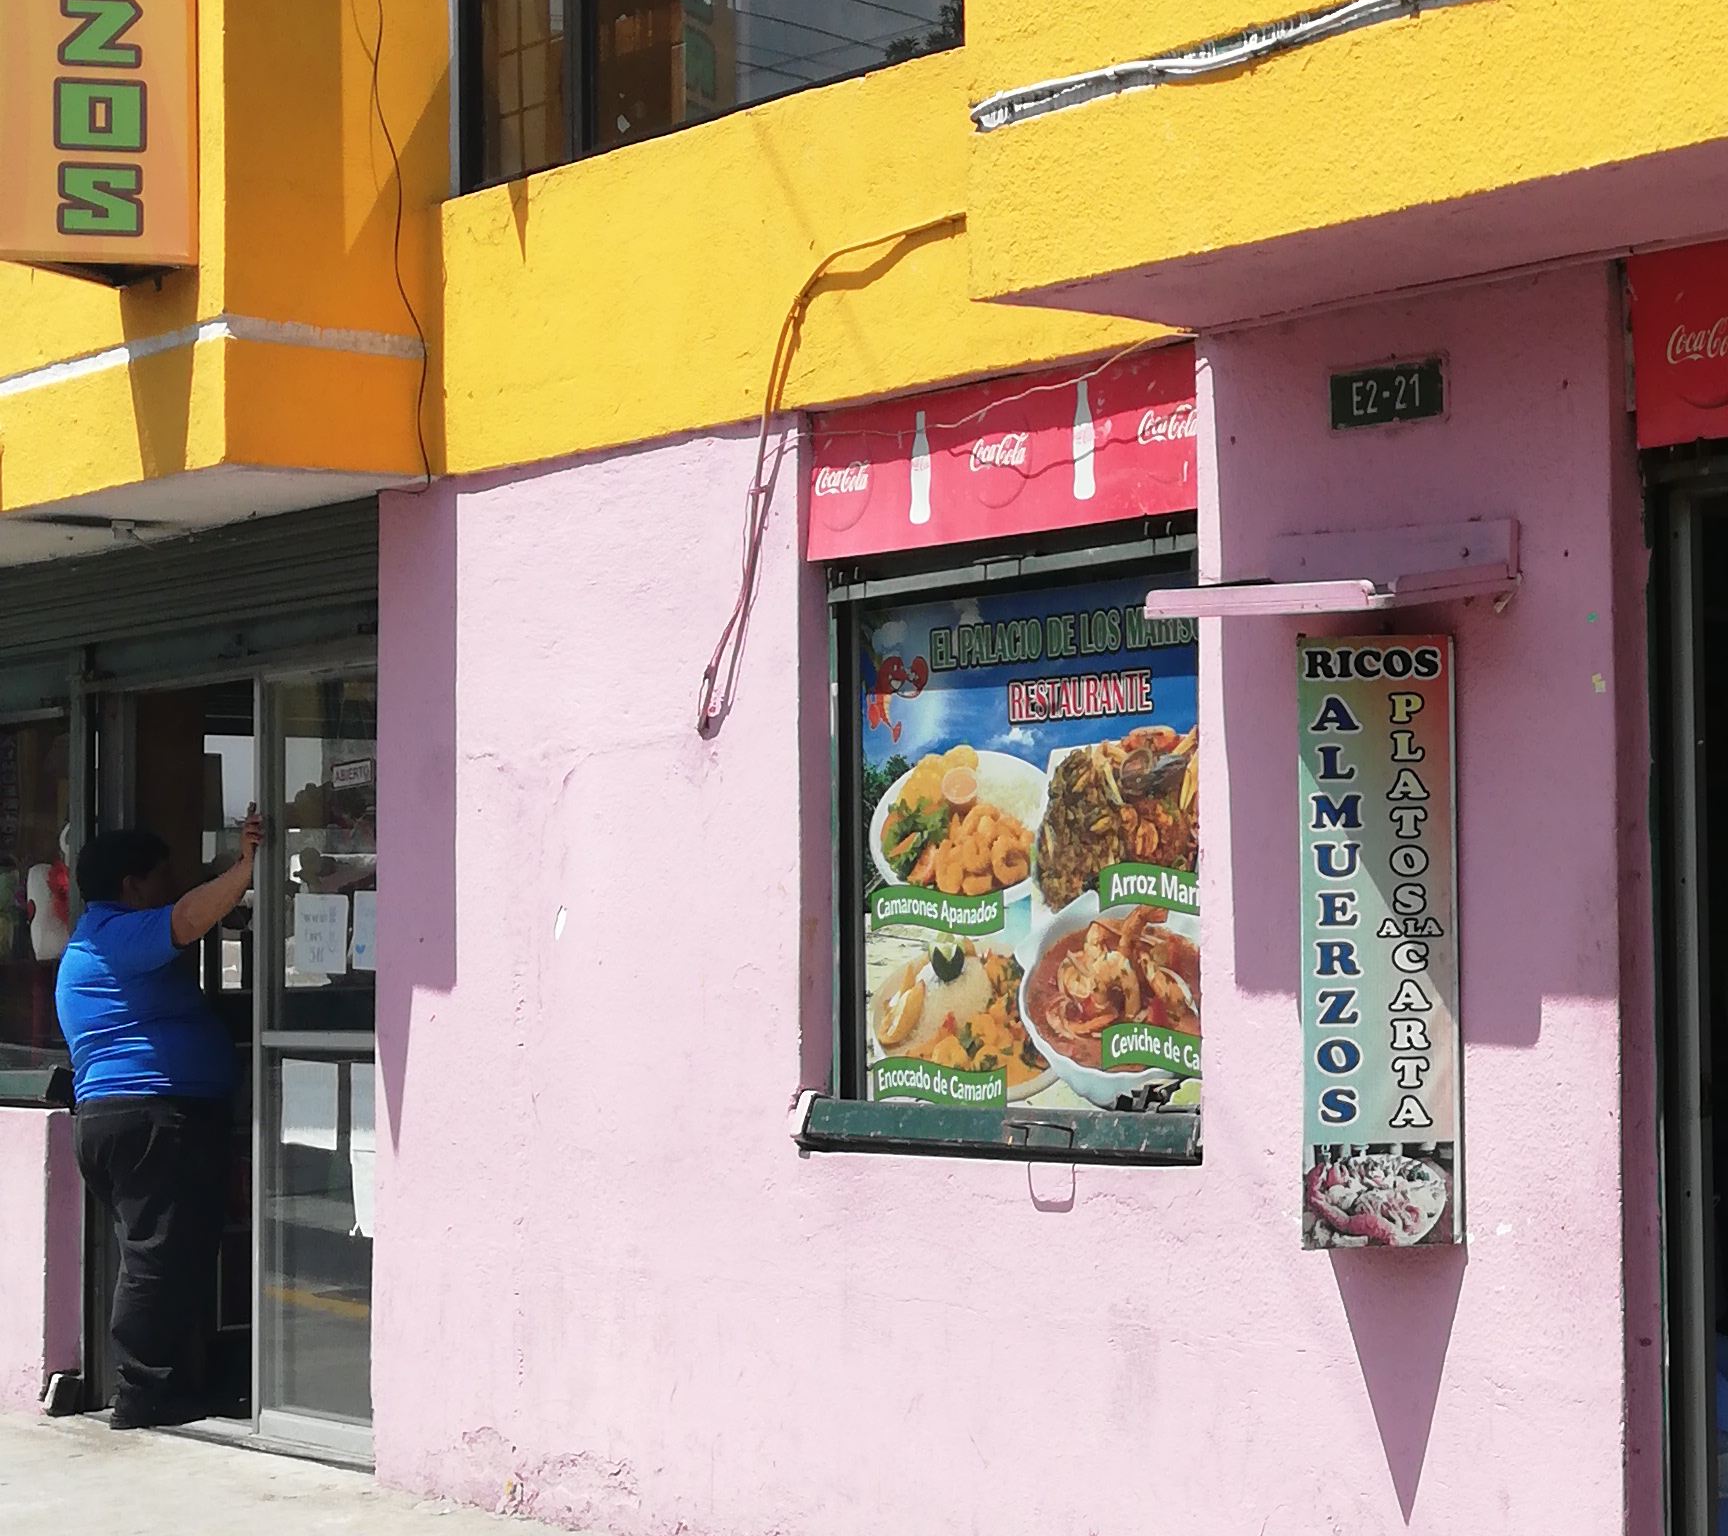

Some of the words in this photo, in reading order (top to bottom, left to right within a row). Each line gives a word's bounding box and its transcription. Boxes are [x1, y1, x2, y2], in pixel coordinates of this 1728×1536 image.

[1352, 373, 1420, 416] E2-21
[930, 627, 956, 671] EL
[957, 616, 1043, 667] PALACIO
[1046, 614, 1078, 659] DE
[1079, 606, 1121, 655] LOS
[1304, 647, 1441, 679] RICOS
[1008, 669, 1153, 724] RESTAURANTE
[334, 765, 369, 782] ABIERTO
[1386, 691, 1430, 917] PLATOS
[1111, 872, 1157, 901] Arroz
[877, 896, 938, 920] Camarones
[941, 900, 998, 928] Apanados
[1310, 695, 1363, 1127] ALMUERZOS
[1377, 918, 1401, 938] A
[1403, 917, 1444, 938] LA
[1111, 1027, 1160, 1058] Ceviche
[1163, 1037, 1181, 1063] de
[1387, 939, 1434, 1129] CARTA
[878, 1065, 931, 1092] Encocado
[933, 1071, 948, 1094] de
[950, 1074, 1002, 1101] Camarón
